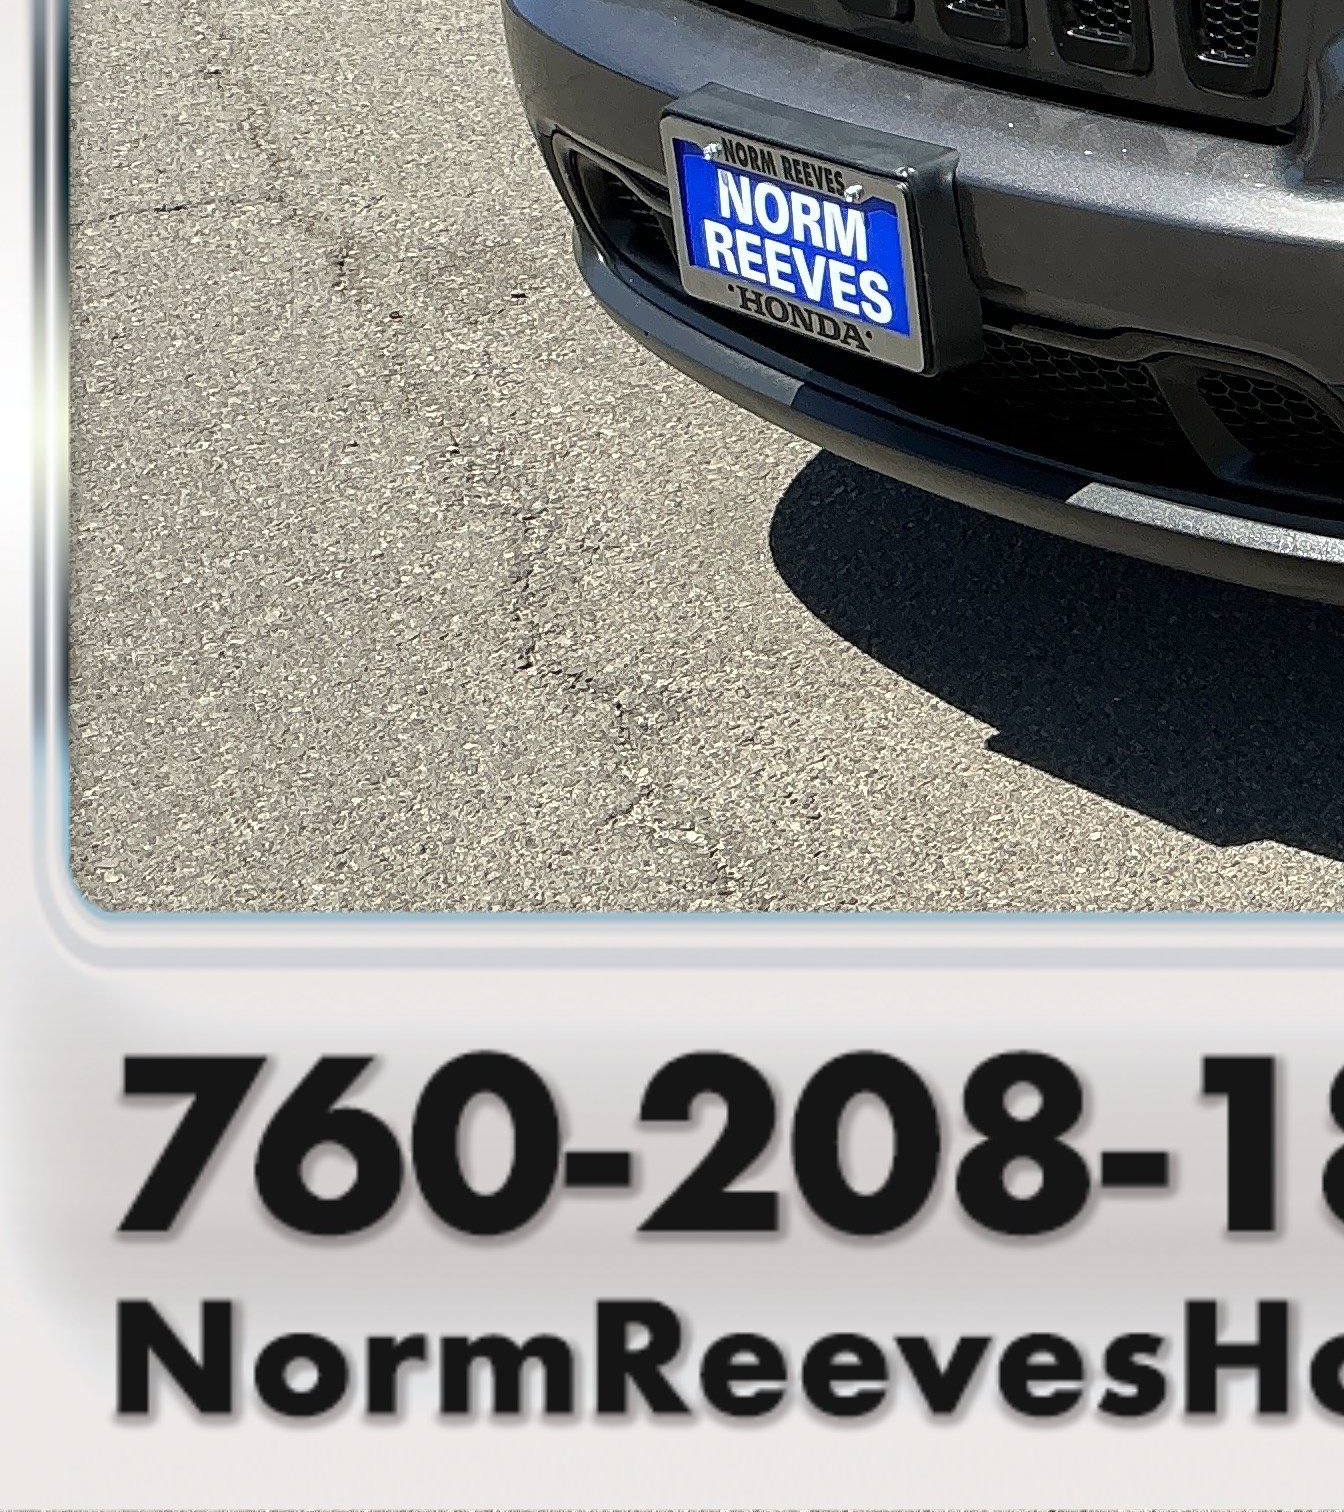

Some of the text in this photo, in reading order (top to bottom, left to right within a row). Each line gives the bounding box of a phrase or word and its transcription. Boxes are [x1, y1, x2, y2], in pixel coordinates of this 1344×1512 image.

[720, 137, 846, 196] NORM REEVES
[716, 168, 869, 263] NORM
[703, 218, 893, 325] REEVES
[737, 286, 871, 353] HONDA
